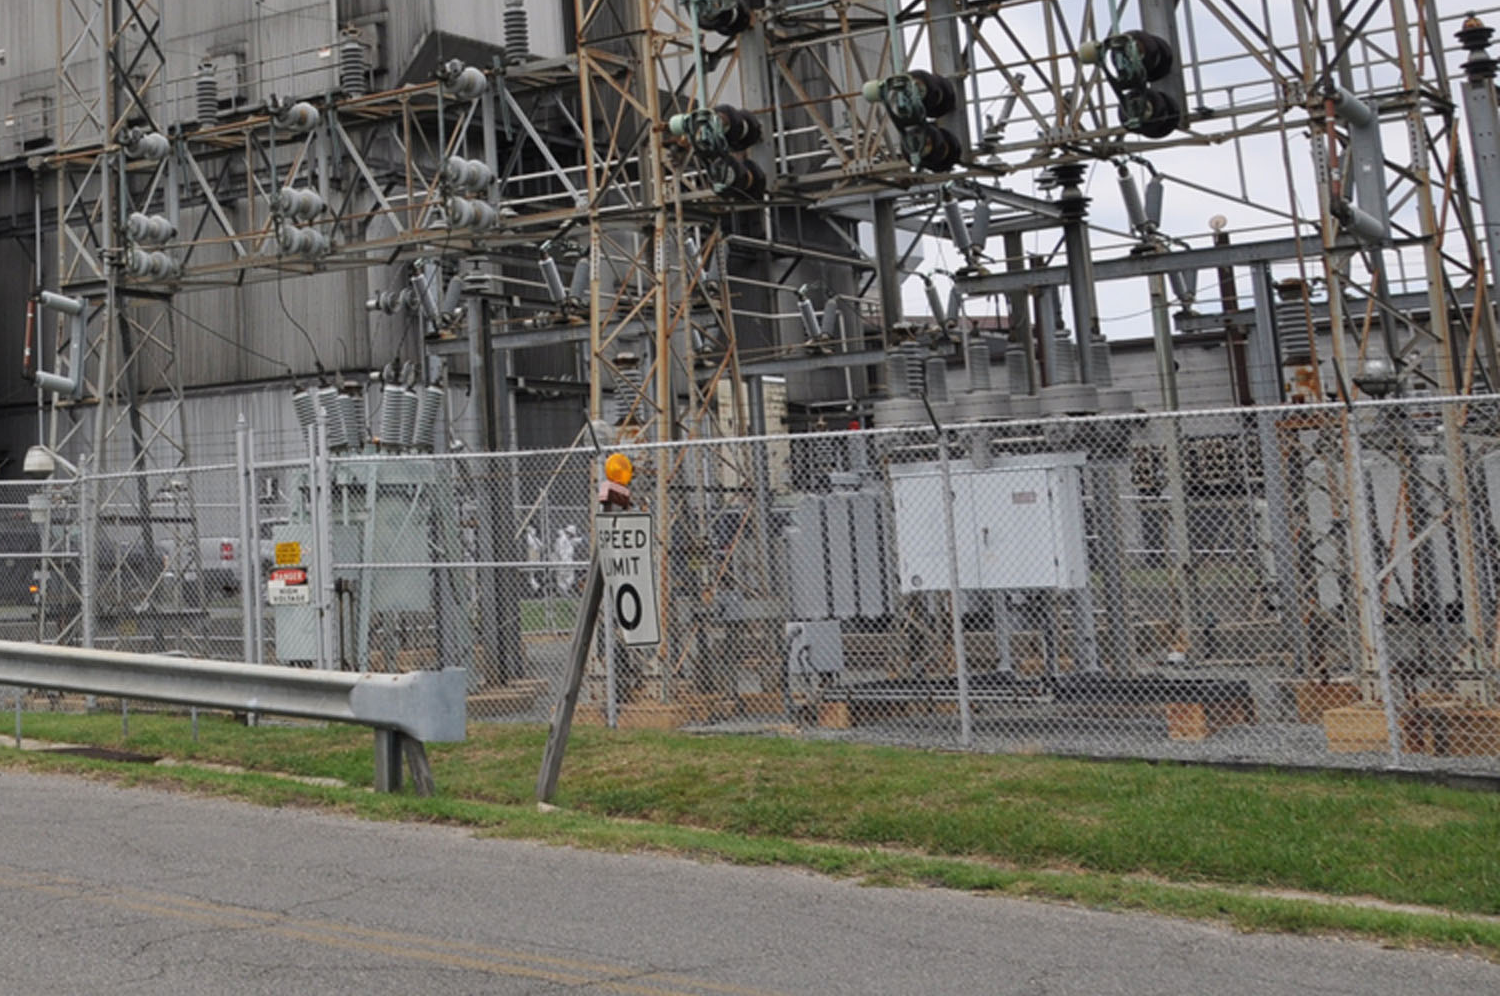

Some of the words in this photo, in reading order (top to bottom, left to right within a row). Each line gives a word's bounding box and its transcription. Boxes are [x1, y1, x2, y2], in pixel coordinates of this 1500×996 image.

[598, 529, 647, 549] SPEED
[603, 556, 640, 577] LIMIT
[274, 571, 303, 581] DANGER
[273, 595, 305, 603] VOLTAGE
